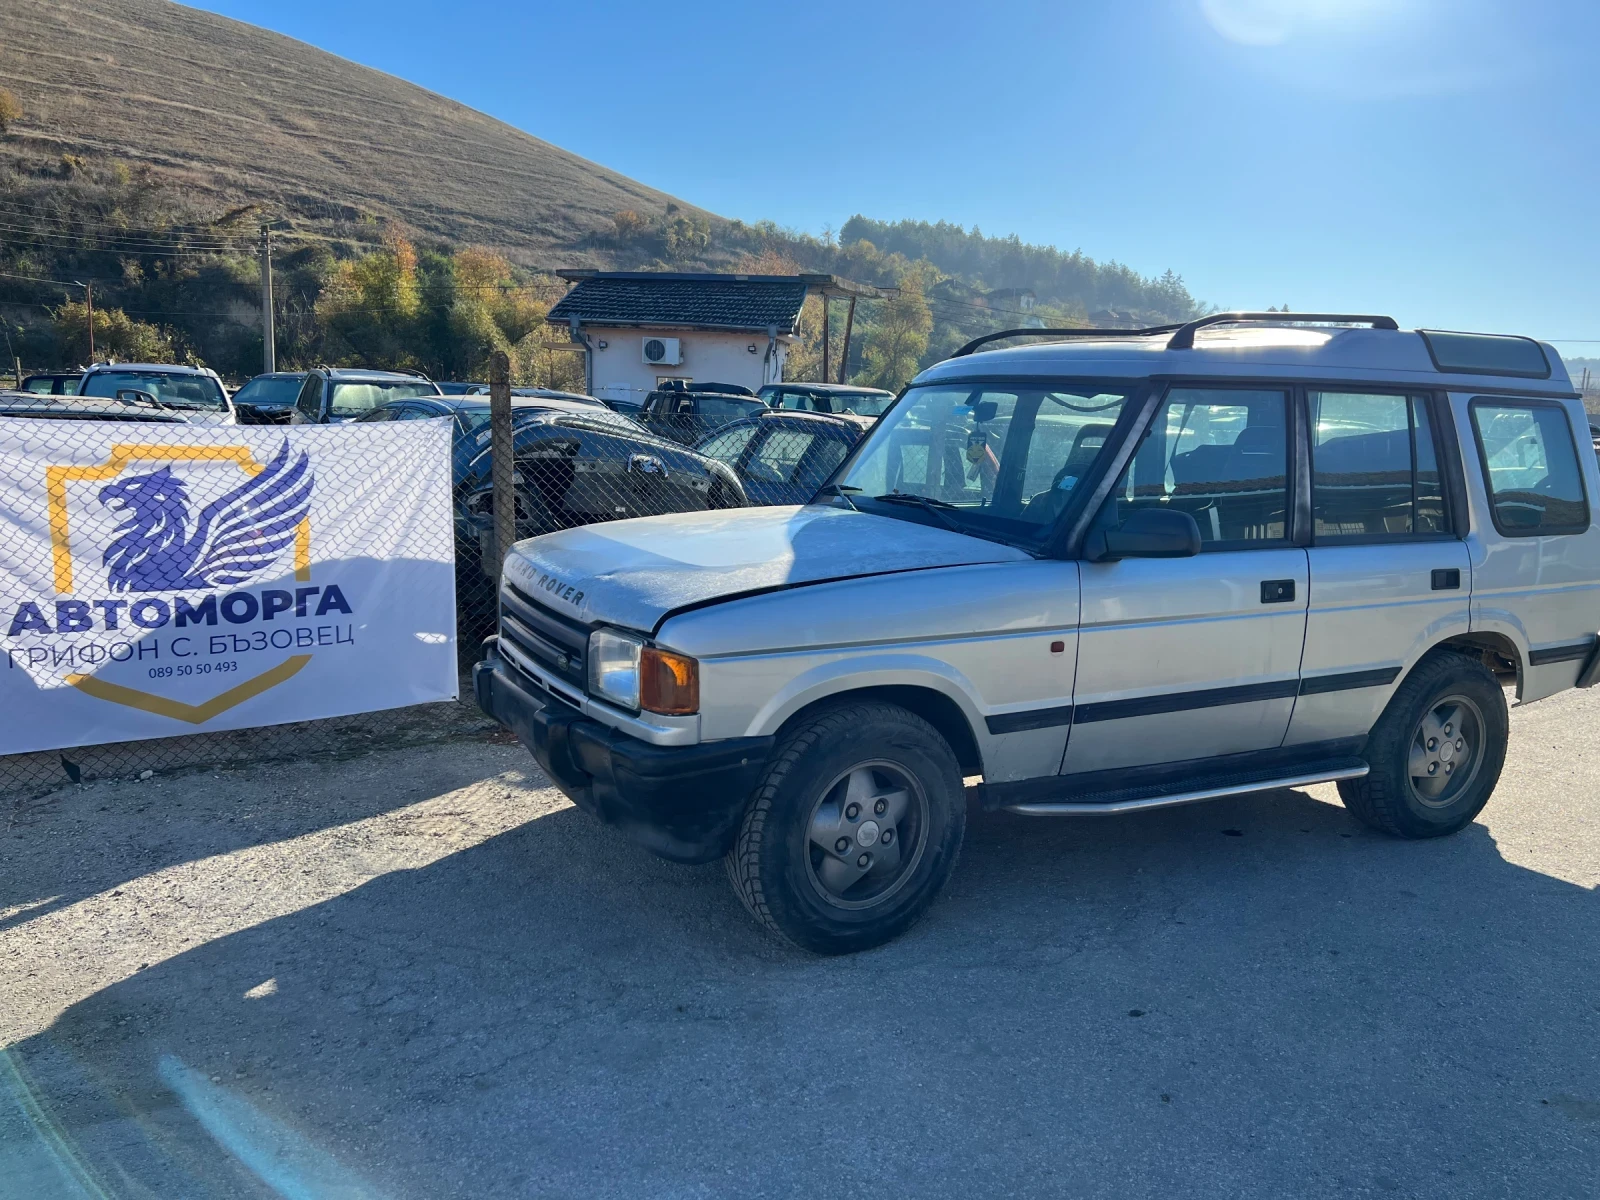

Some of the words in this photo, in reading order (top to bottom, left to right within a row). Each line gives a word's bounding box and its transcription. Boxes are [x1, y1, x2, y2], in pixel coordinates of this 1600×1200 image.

[537, 573, 585, 606] ROVER
[7, 584, 353, 636] АВТОМОРГА
[8, 638, 159, 669] ГРИФОН
[171, 637, 198, 657] С.
[209, 624, 354, 655] БЪЗОВЕЦ
[148, 666, 173, 679] 089
[177, 665, 193, 676] 50
[196, 663, 212, 674] 50
[215, 661, 238, 673] 493
